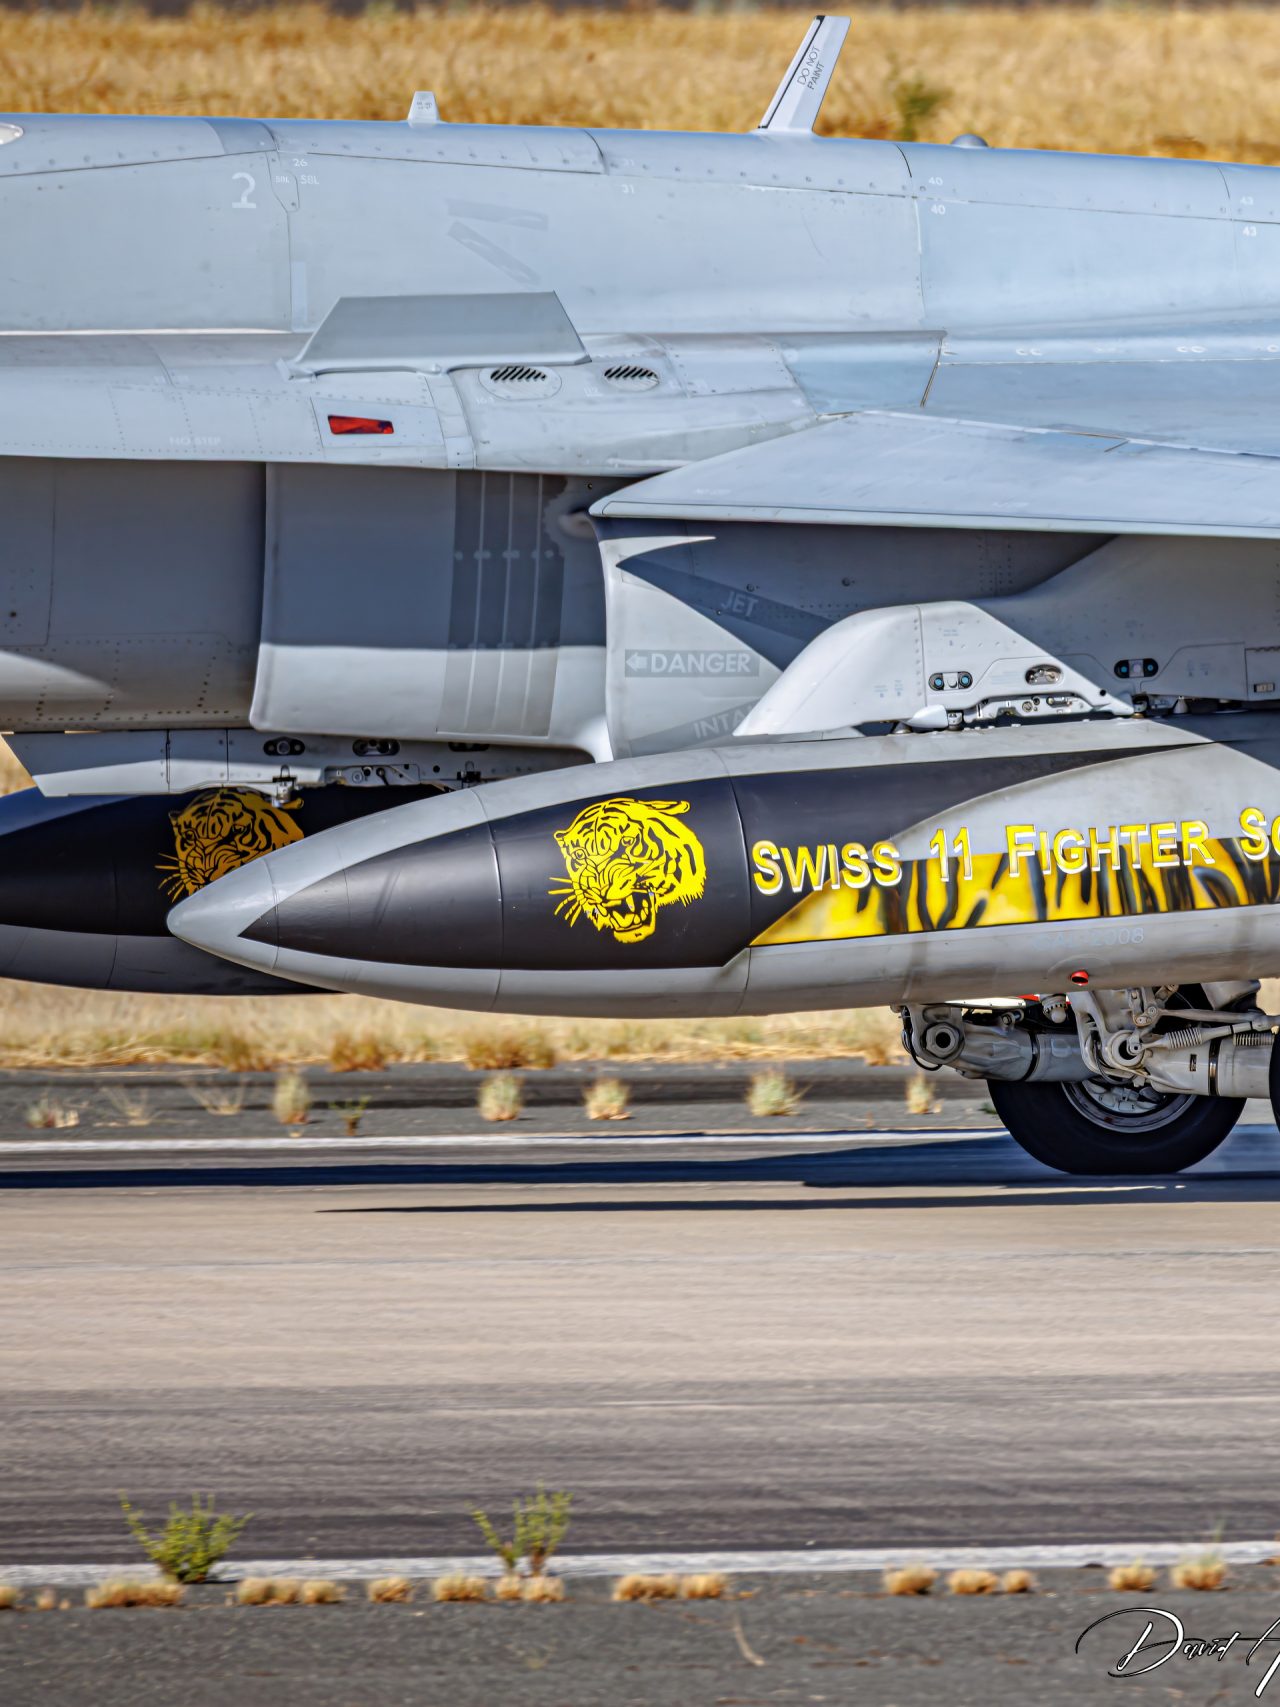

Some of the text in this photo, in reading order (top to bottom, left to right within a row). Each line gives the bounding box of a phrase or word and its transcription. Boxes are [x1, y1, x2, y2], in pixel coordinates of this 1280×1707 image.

[797, 45, 820, 85] DO NOT
[807, 61, 825, 90] PAINT
[231, 171, 257, 209] 2
[928, 176, 943, 186] 40
[930, 204, 946, 215] 40
[1242, 226, 1257, 237] 43
[721, 590, 760, 617] JET
[650, 652, 751, 674] DANGER
[693, 706, 753, 739] INTA
[752, 840, 903, 896] SWISS
[930, 826, 973, 882] 11
[1005, 820, 1217, 878] FIGHTER
